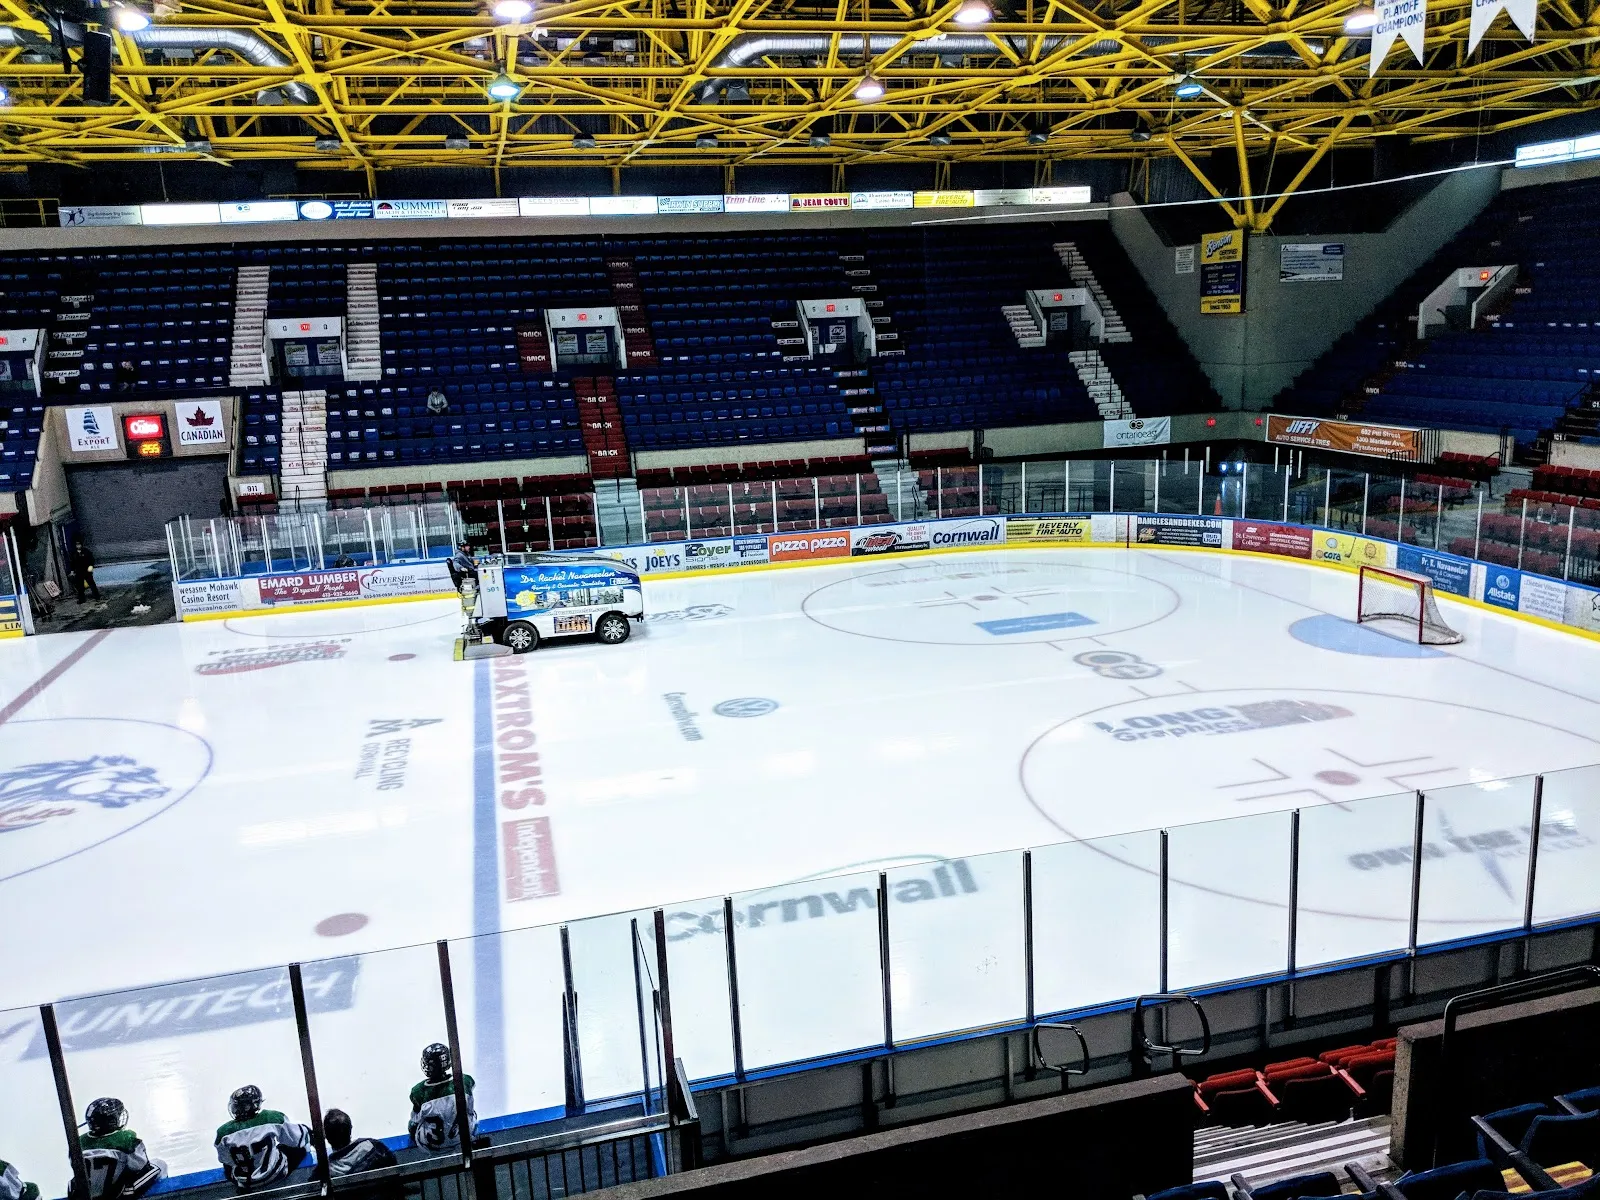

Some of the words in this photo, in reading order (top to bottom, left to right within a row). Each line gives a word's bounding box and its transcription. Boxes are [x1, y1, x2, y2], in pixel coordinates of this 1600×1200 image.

[1383, 0, 1420, 19] PLAYOFF
[1376, 11, 1424, 35] CHAMPIONS
[394, 201, 442, 210] SUMMIT
[824, 198, 848, 206] COUTU
[1285, 419, 1320, 435] JIFFY
[78, 437, 110, 446] EXPORT
[181, 429, 223, 442] CANADIAN
[1276, 434, 1290, 442] AUTO
[1290, 436, 1311, 444] SERVICE
[933, 525, 1000, 545] Cornwall
[1243, 533, 1267, 541] Lawrence
[772, 540, 809, 556] pizza
[810, 537, 847, 552] pizza
[645, 554, 681, 572] JOEY'S
[1323, 551, 1342, 561] cora
[209, 581, 239, 592] Mohawk
[260, 577, 304, 589] EMARD
[309, 572, 357, 585] LUMBER
[371, 575, 416, 585] RIVERSIDE
[520, 575, 536, 584] Dr.
[274, 588, 288, 596] The
[292, 585, 320, 596] Drywall
[323, 583, 345, 592] People
[1487, 587, 1516, 602] Allstate
[181, 595, 205, 604] Casino
[207, 593, 230, 602] Resort
[1093, 707, 1237, 733] LONG
[494, 653, 547, 810] BAXTROM'S
[1113, 718, 1250, 742] Graphics
[376, 738, 412, 791] RECYCLING
[514, 820, 547, 898] Independent
[60, 970, 346, 1037] UNITECH
